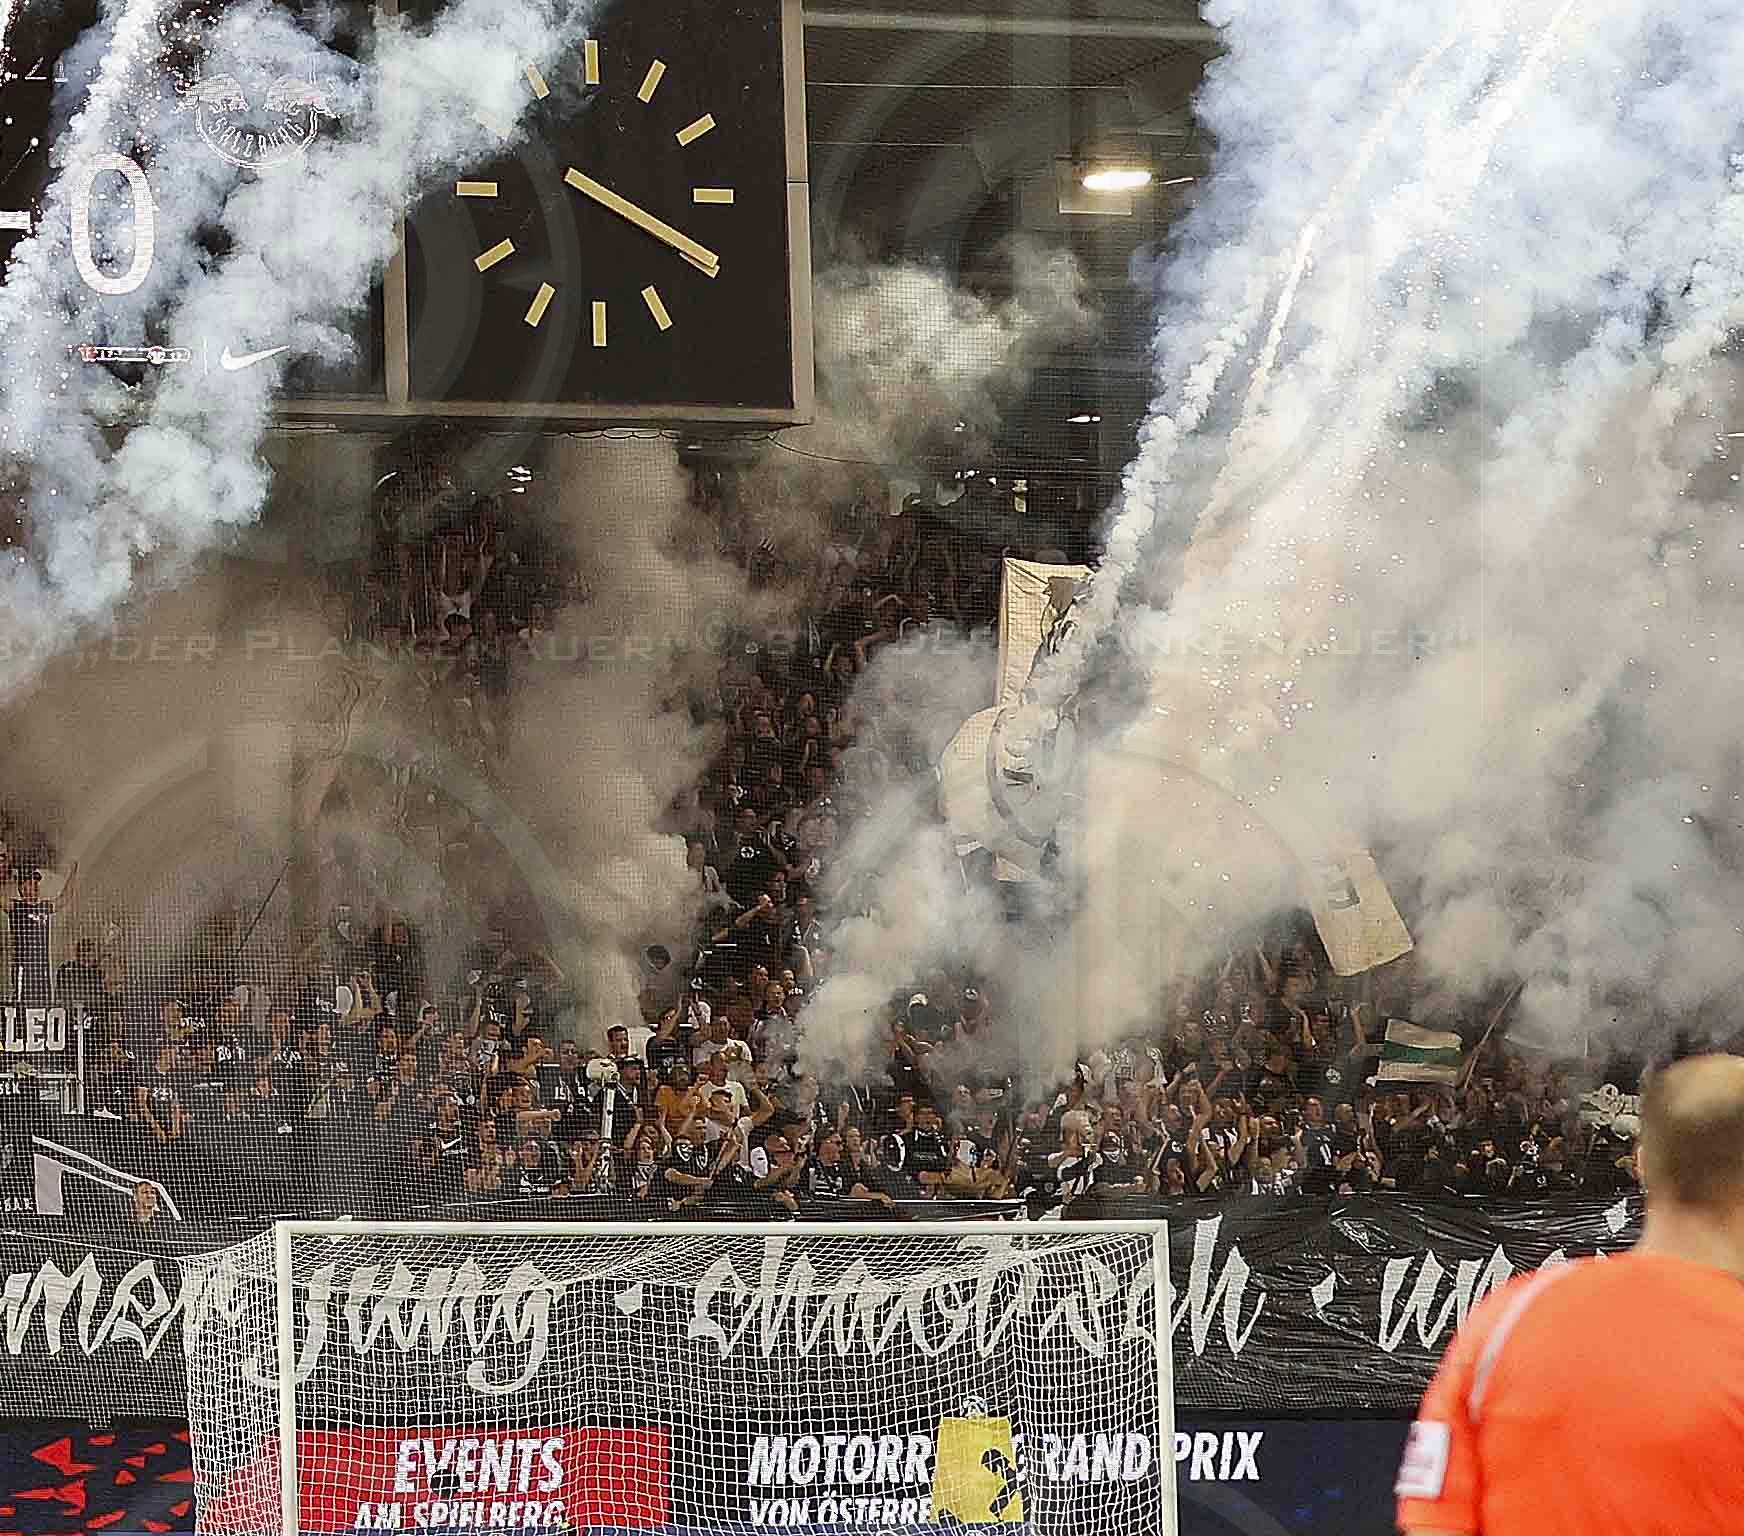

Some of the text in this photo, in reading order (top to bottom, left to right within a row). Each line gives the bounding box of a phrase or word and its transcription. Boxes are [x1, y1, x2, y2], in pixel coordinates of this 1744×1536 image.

[68, 153, 157, 295] 0
[393, 1438, 565, 1494] EVENTS
[747, 1435, 934, 1486] MOTORR
[1174, 1431, 1264, 1481] PRIX
[354, 1501, 569, 1529] AM SPIELBERG
[750, 1491, 933, 1527] VON ÖSTERRE
